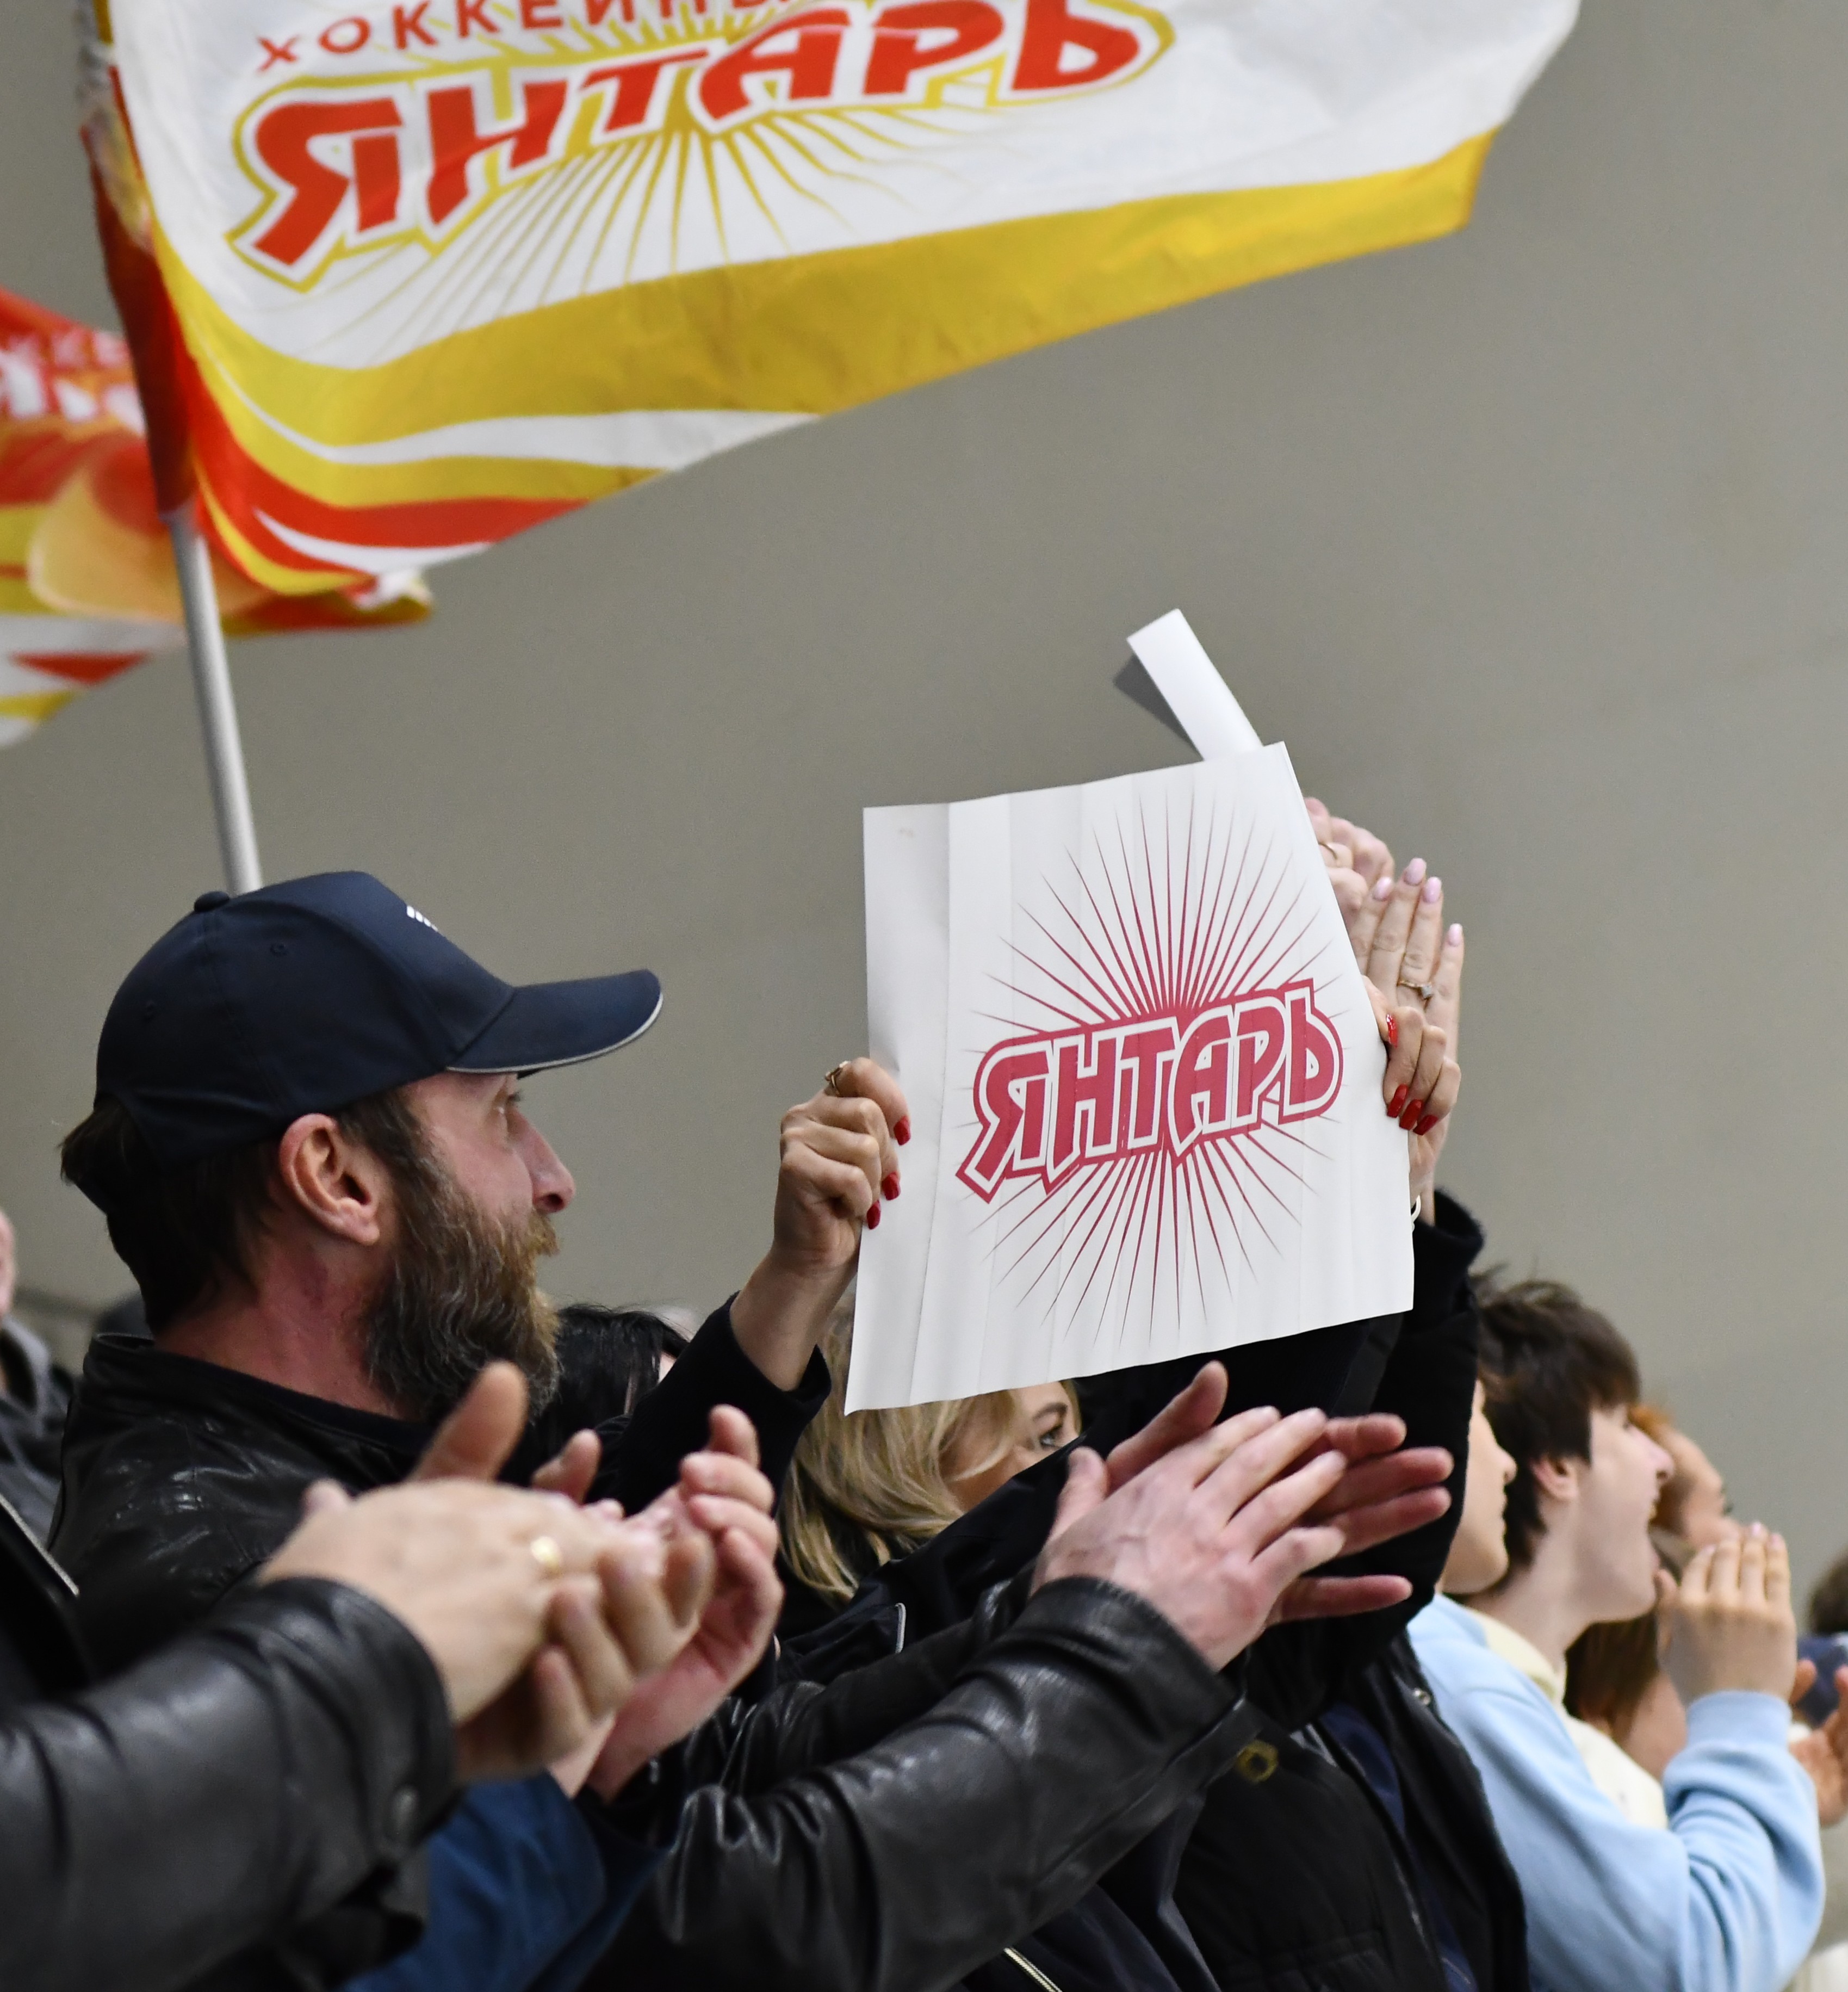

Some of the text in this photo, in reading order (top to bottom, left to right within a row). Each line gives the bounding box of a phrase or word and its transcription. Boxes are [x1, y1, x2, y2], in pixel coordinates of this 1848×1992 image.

[251, 0, 1142, 267] ЯНТАРЬ
[257, 0, 789, 74] ХОККЕ
[960, 986, 1341, 1196] ЯНТАРЬ
